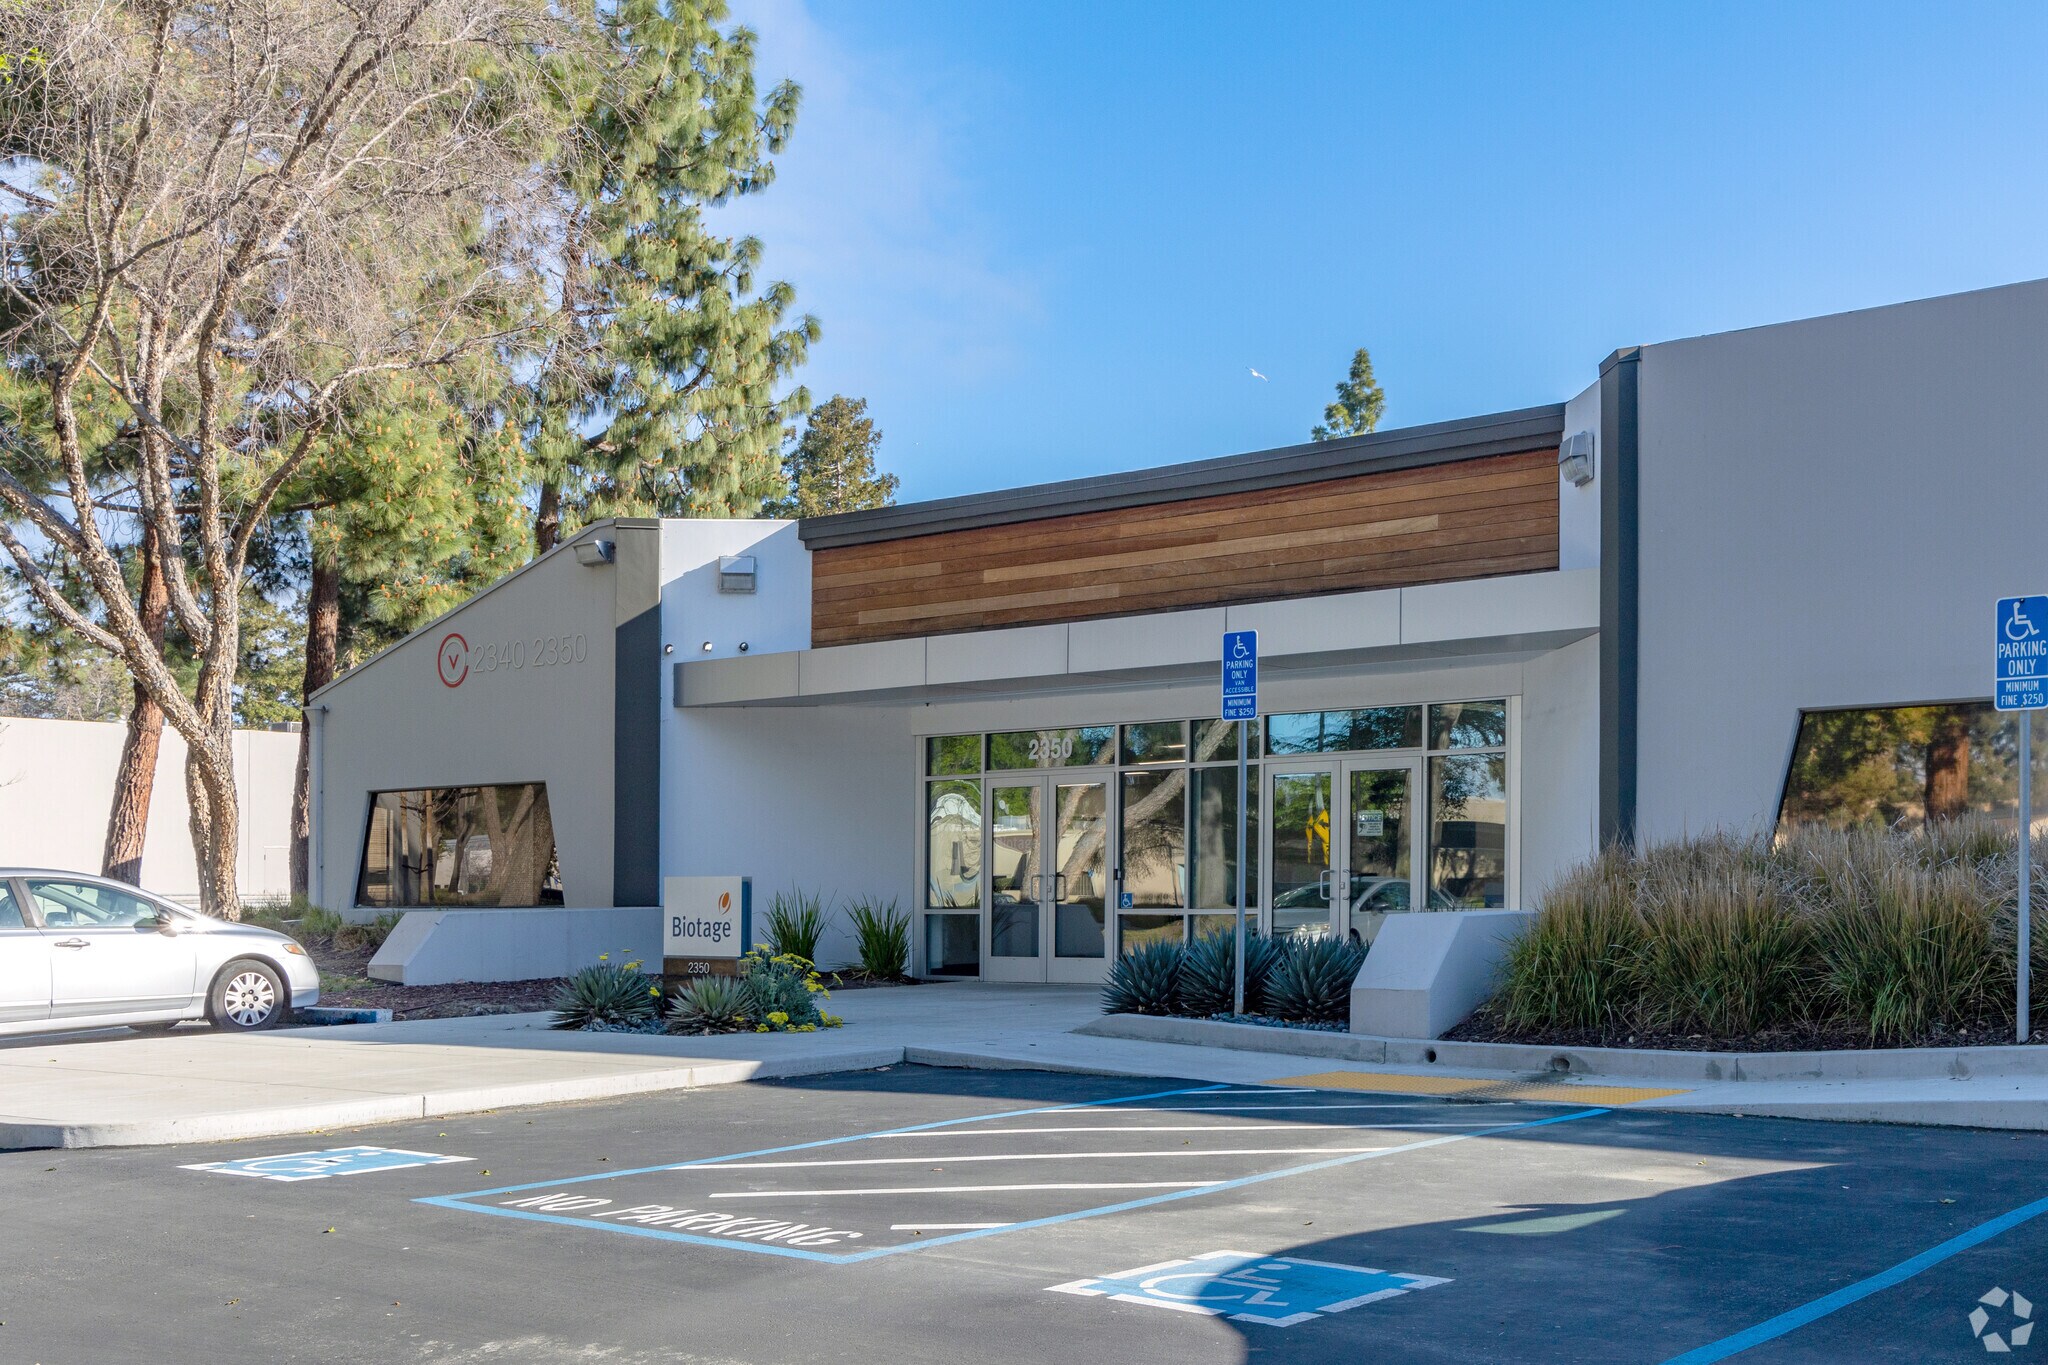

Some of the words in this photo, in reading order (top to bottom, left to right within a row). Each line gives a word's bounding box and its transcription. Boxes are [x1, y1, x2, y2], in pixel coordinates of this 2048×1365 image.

[473, 640, 525, 674] 2340
[532, 633, 588, 667] 2350
[1999, 640, 2047, 659] PARKING
[1226, 659, 1254, 669] PARKING
[2008, 659, 2037, 676] ONLY
[1231, 670, 1248, 679] ONLY
[2005, 680, 2039, 692] MINIMUM
[1227, 698, 1252, 707] MINIMUM
[2001, 694, 2018, 706] FINE
[2022, 693, 2044, 705] $250
[1224, 708, 1237, 717] FINE
[1238, 707, 1254, 716] $250
[1028, 737, 1073, 760] 2350
[672, 916, 731, 943] Biotage
[688, 962, 710, 974] 2350
[498, 1193, 612, 1211] NO
[590, 1204, 863, 1246] PARKING
